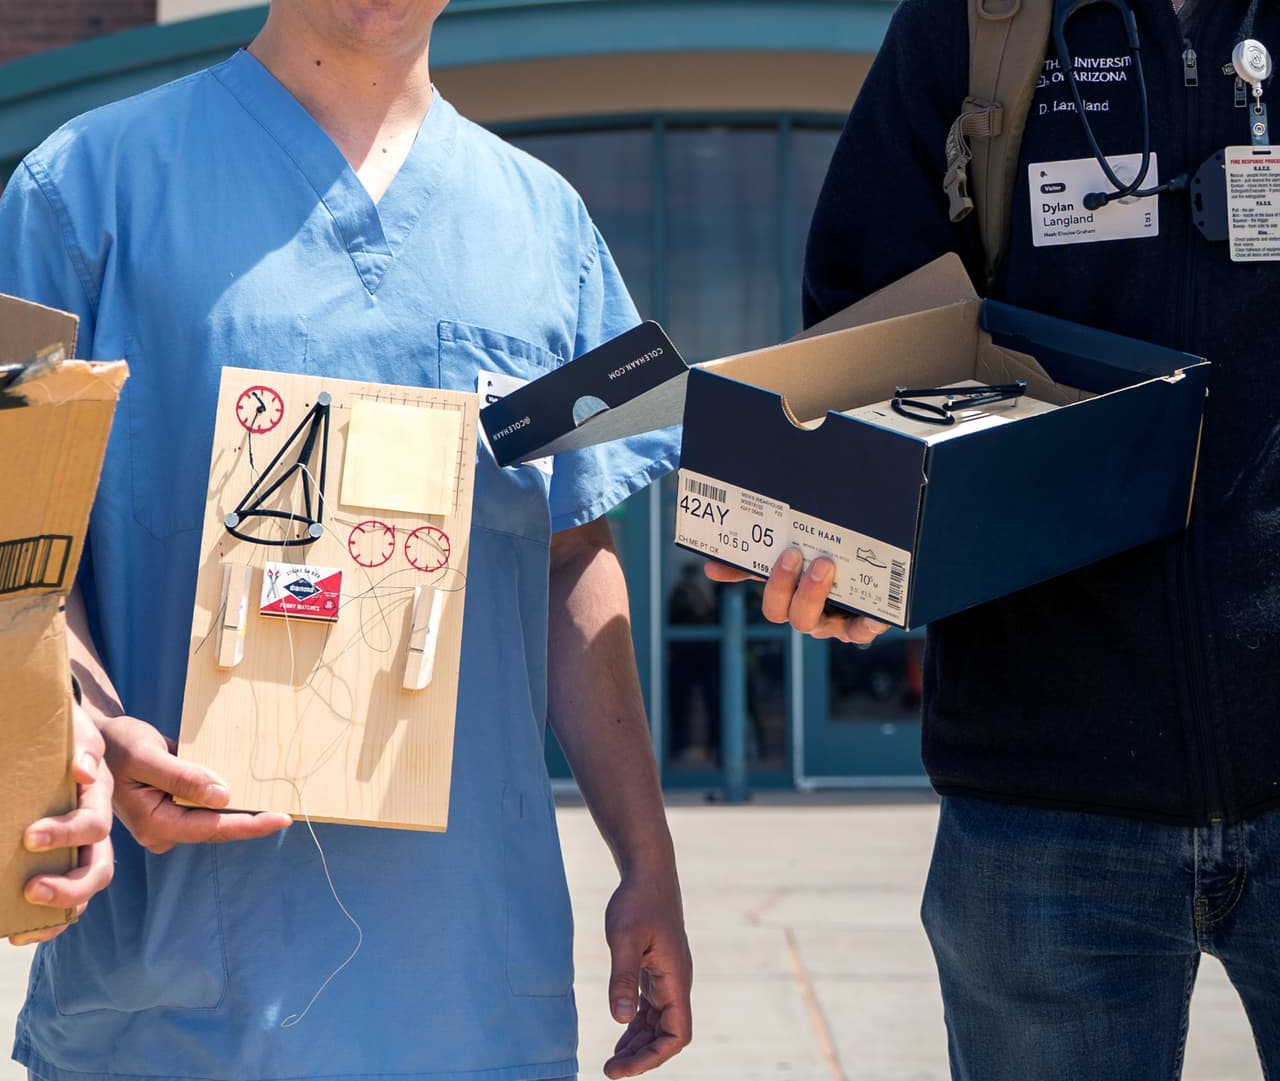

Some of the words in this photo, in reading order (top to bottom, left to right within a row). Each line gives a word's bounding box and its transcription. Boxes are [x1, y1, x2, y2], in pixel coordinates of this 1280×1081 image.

[1073, 55, 1132, 69] NIVERSIT
[1053, 99, 1109, 114] Lanland
[1042, 203, 1074, 215] Dylan
[1044, 213, 1094, 227] Langland
[608, 347, 664, 381] COLEHAAN.COM
[680, 495, 730, 526] 42AY
[718, 533, 739, 549] 10.5
[741, 541, 750, 552] D
[751, 524, 774, 548] 05
[793, 521, 816, 535] COLE
[818, 530, 842, 545] HAAN
